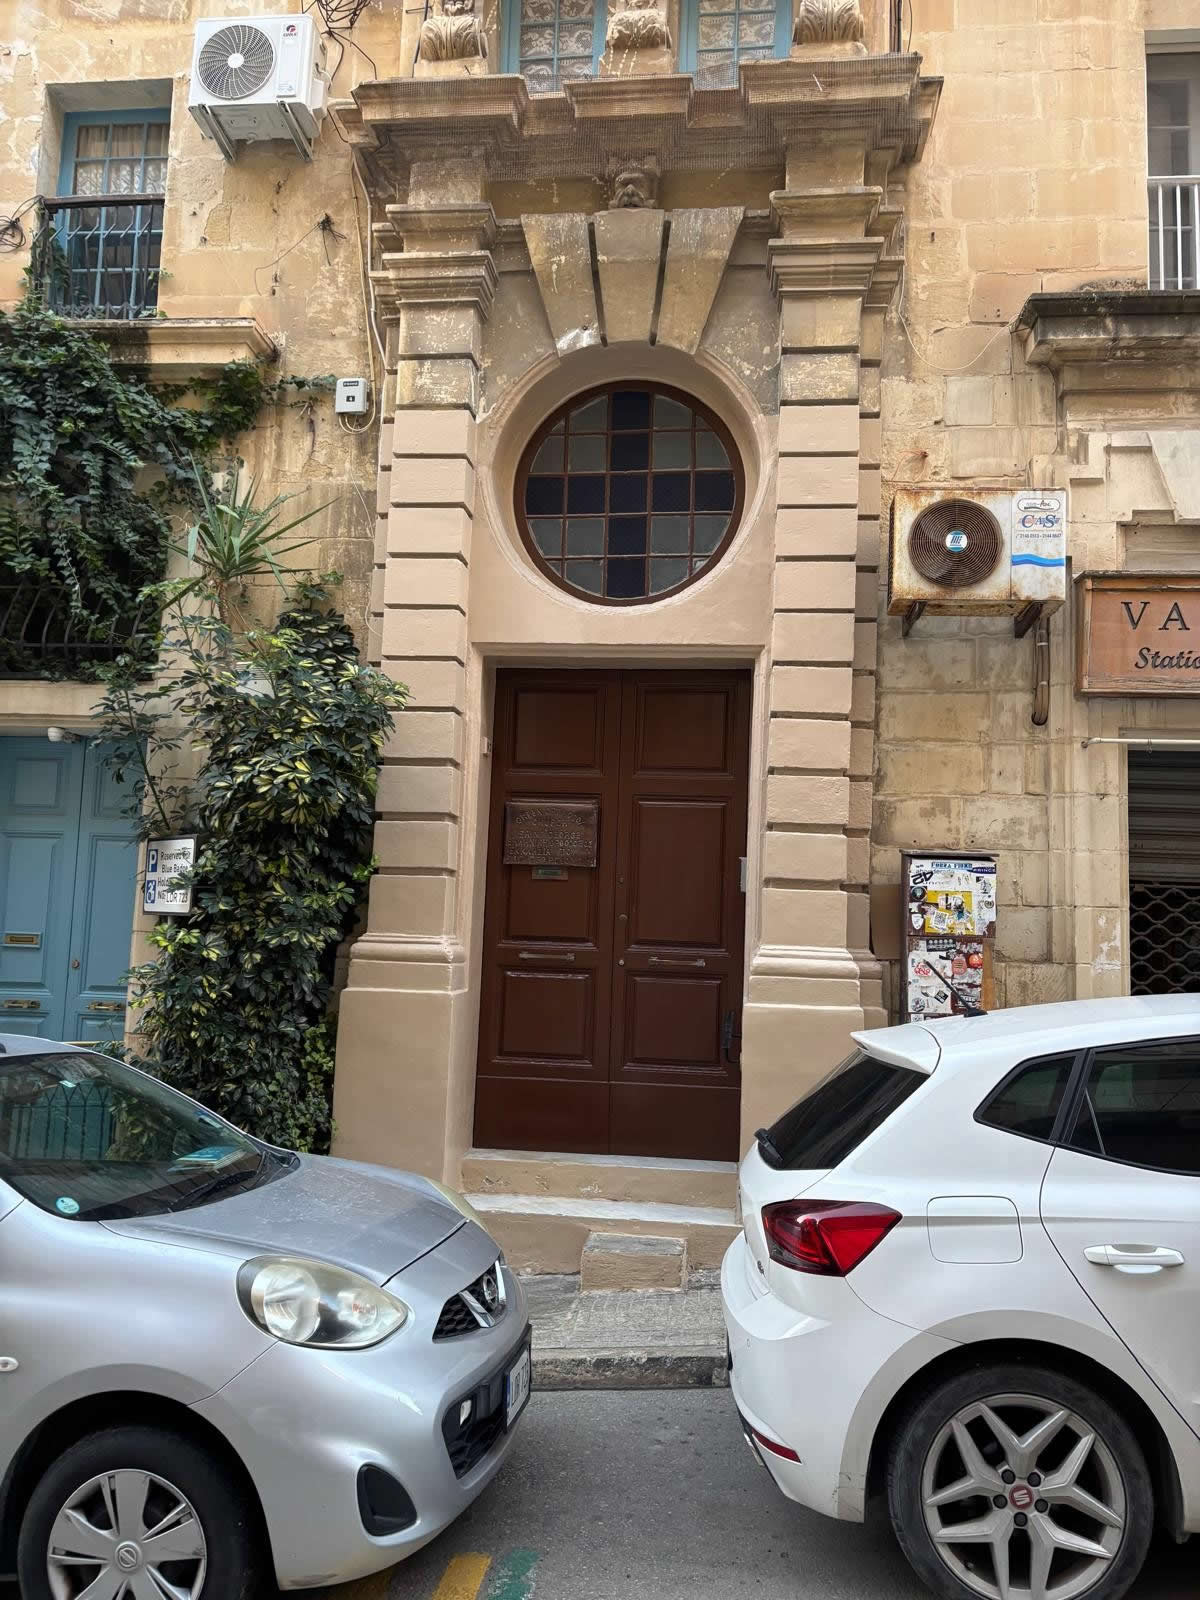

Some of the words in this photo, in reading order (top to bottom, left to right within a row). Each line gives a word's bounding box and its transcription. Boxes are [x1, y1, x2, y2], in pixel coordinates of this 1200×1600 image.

[1022, 515, 1057, 528] CAS
[160, 851, 182, 861] Reserved
[161, 864, 173, 873] Blue
